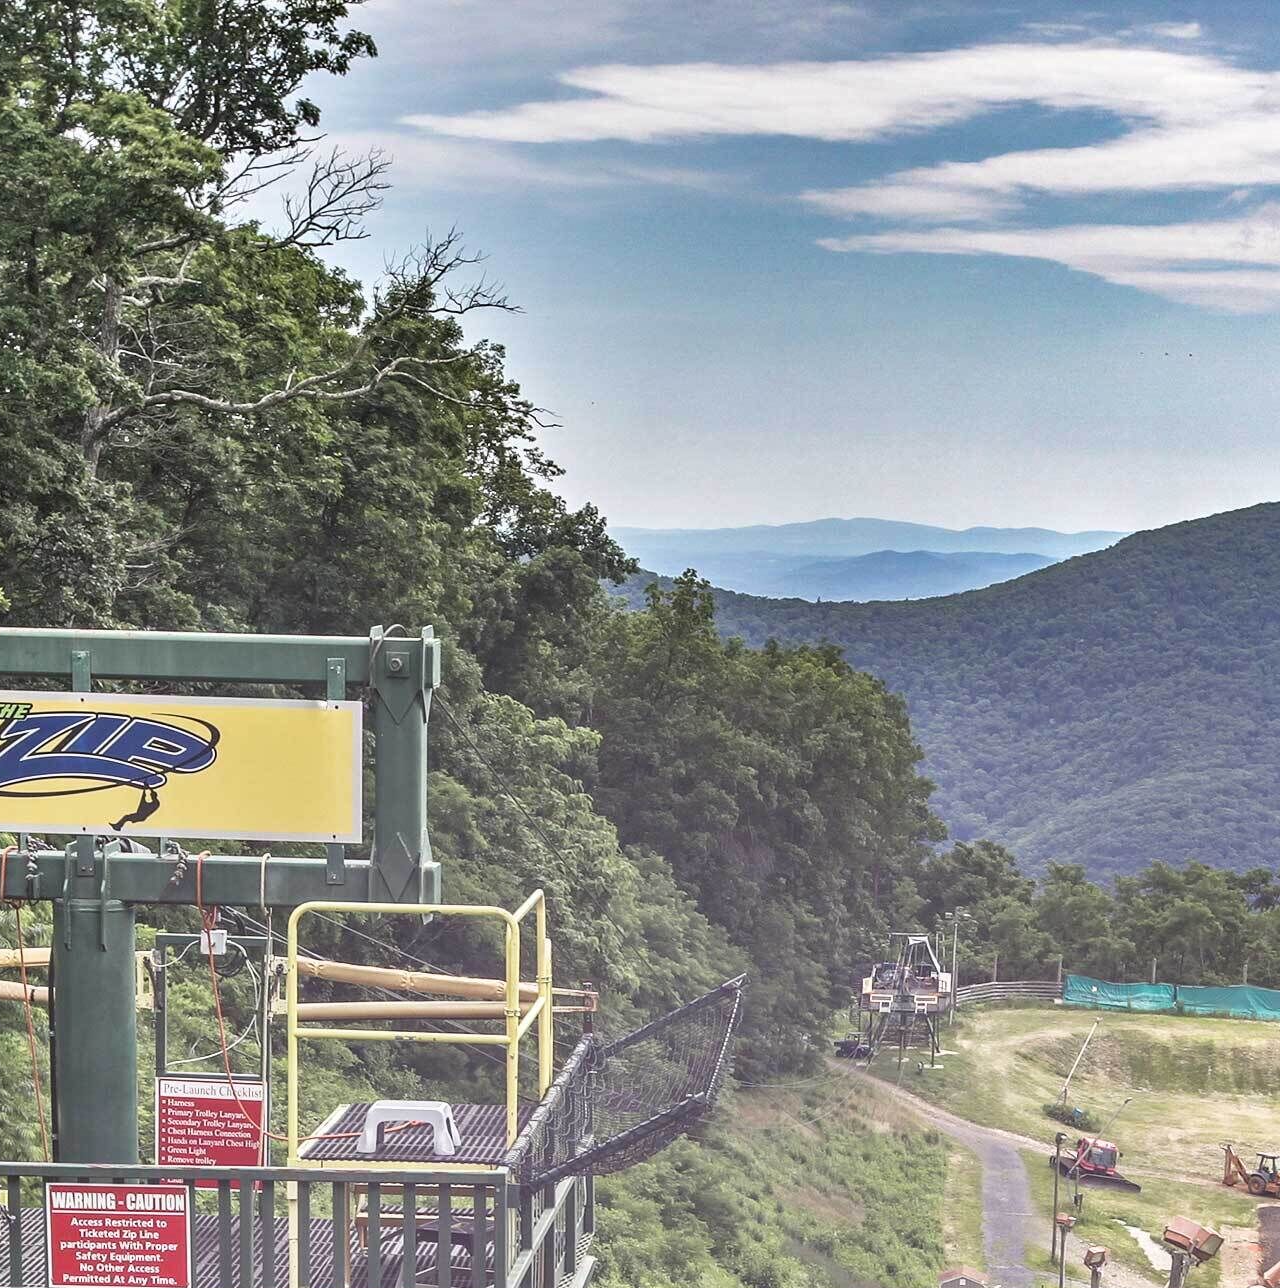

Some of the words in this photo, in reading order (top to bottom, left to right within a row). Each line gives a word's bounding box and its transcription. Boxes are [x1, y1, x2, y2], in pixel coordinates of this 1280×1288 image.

[163, 1083, 218, 1095] Pre-Launch
[219, 1085, 263, 1098] Chcklist
[167, 1099, 195, 1107] Harness
[167, 1108, 194, 1117] Primary
[195, 1109, 218, 1119] Trolley
[167, 1118, 201, 1127] Secondary
[202, 1119, 225, 1128] Trolley
[167, 1127, 186, 1135] Chest
[187, 1128, 213, 1136] Harness
[214, 1129, 252, 1138] Connection
[199, 1138, 224, 1147] Lanyard
[225, 1139, 244, 1147] Chest
[167, 1146, 187, 1154] Green
[188, 1146, 206, 1156] Light
[167, 1155, 194, 1163] Remove
[195, 1156, 217, 1166] trolley
[51, 1191, 116, 1210] WARNING
[126, 1193, 184, 1211] CAUTION
[70, 1217, 103, 1227] Access
[104, 1218, 153, 1228] Restricted
[156, 1219, 167, 1228] to
[79, 1229, 120, 1238] Ticketed
[122, 1229, 137, 1241] Zip
[139, 1230, 160, 1239] Line
[60, 1240, 117, 1251] participants
[119, 1241, 143, 1250] With
[145, 1241, 178, 1252] Proper
[76, 1251, 107, 1262] Safety
[109, 1252, 164, 1263] Equipment.
[79, 1263, 93, 1272] No
[96, 1263, 124, 1273] Other
[127, 1264, 160, 1274] Access
[62, 1274, 111, 1284] Permitted
[113, 1275, 125, 1284] At
[127, 1275, 147, 1286] Any
[150, 1276, 177, 1285] Time.
